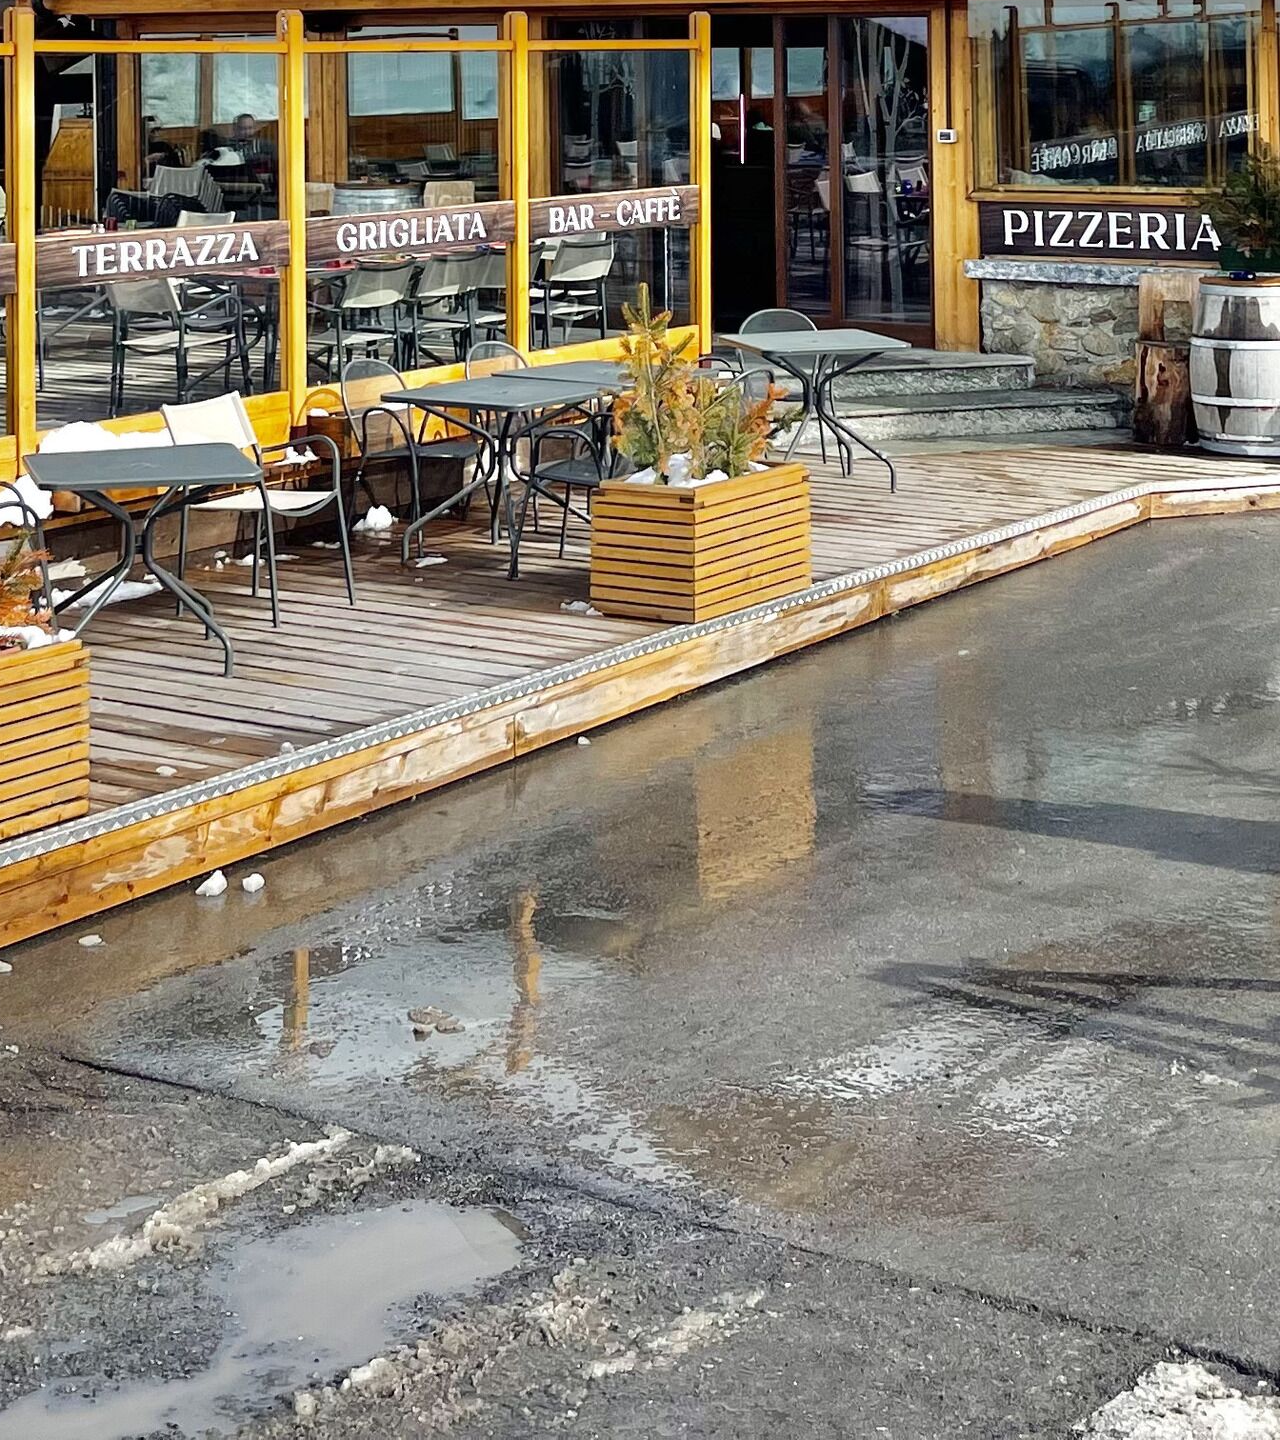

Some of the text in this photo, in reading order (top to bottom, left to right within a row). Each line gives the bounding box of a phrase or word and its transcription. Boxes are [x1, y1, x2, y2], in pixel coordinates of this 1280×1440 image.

[335, 211, 488, 253] GRIGLIATA
[548, 204, 595, 234] BAR
[616, 188, 681, 227] CAFFÈ
[1001, 209, 1223, 251] PIZZERIA
[71, 231, 260, 278] TERRAZZA
